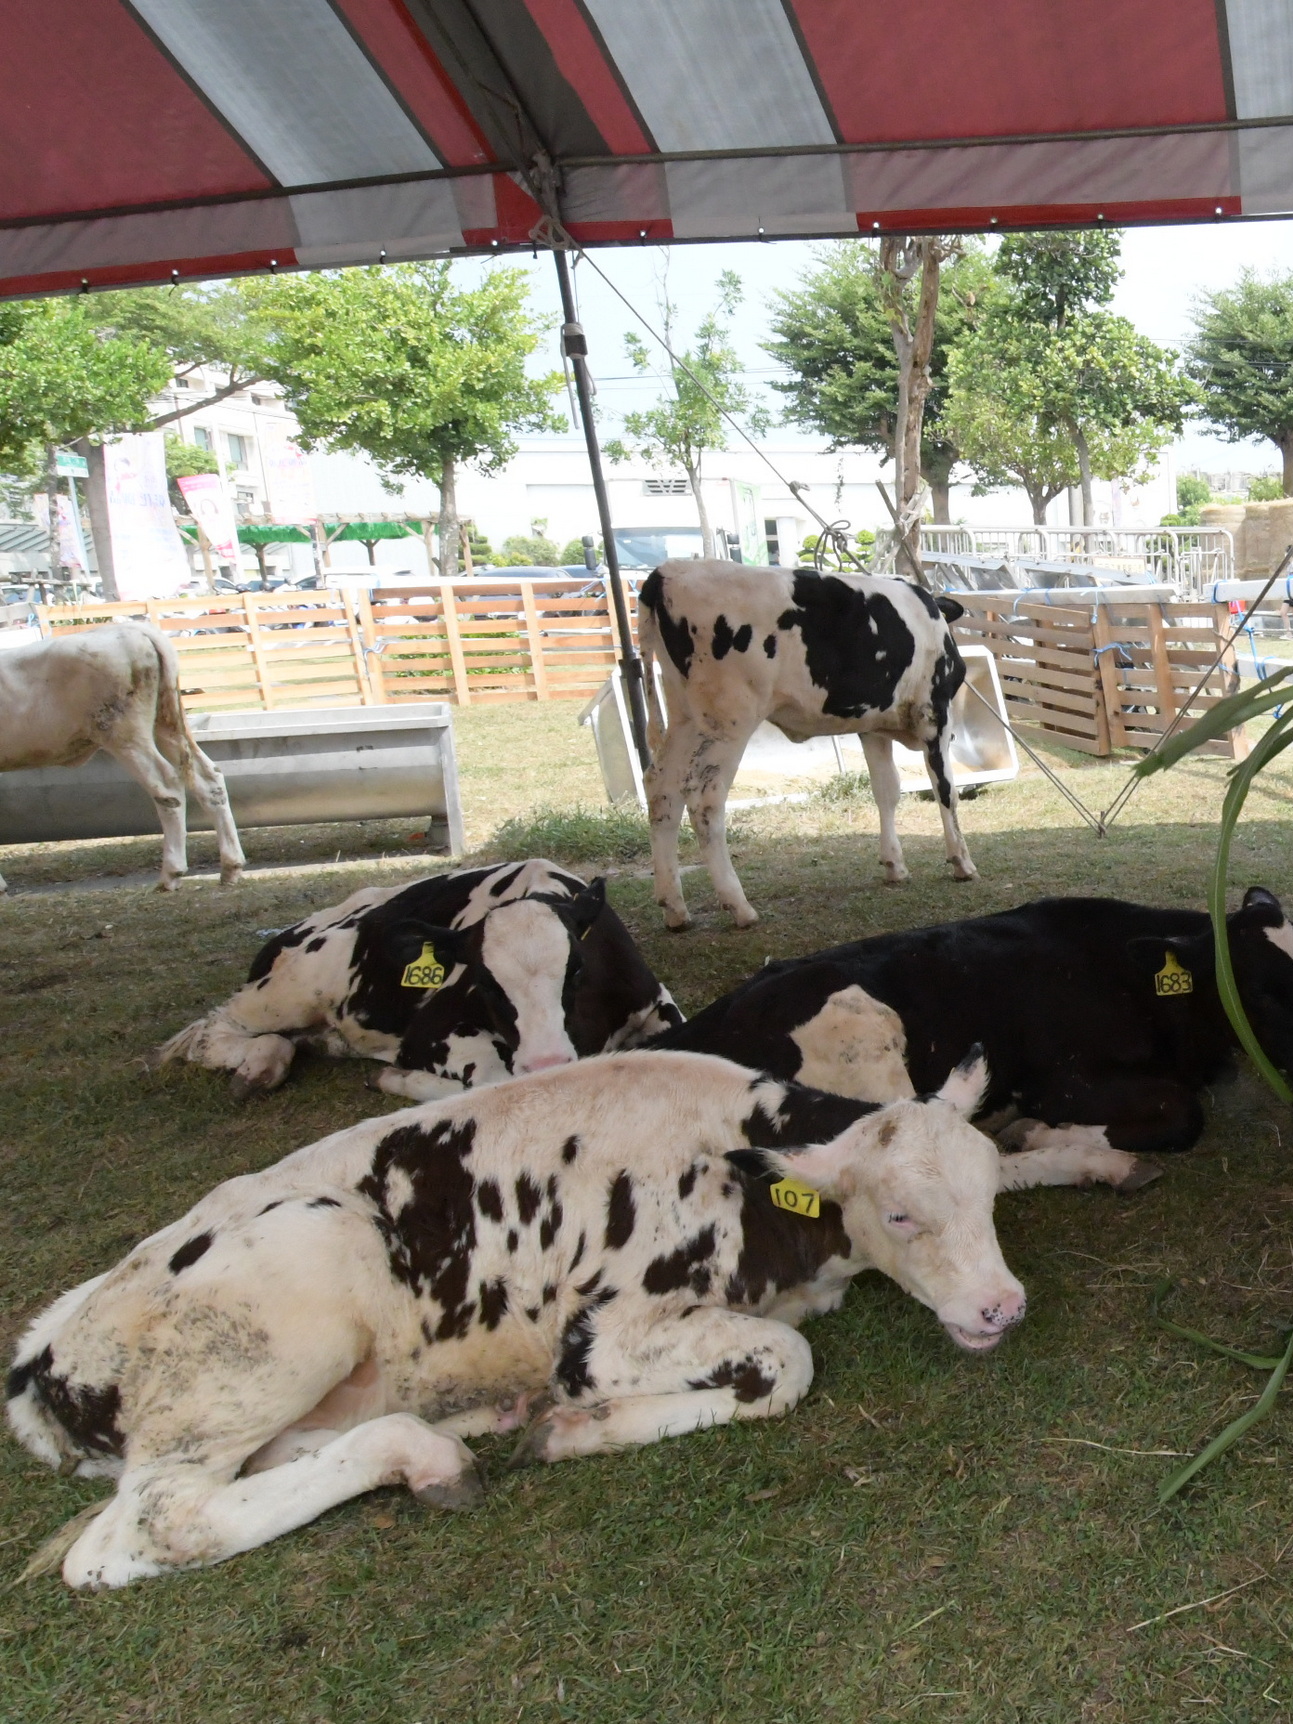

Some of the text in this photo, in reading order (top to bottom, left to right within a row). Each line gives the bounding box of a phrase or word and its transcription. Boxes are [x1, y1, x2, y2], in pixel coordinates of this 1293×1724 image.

[403, 965, 443, 985] 1686
[1156, 972, 1192, 993] 1683
[775, 1188, 815, 1214] 107
